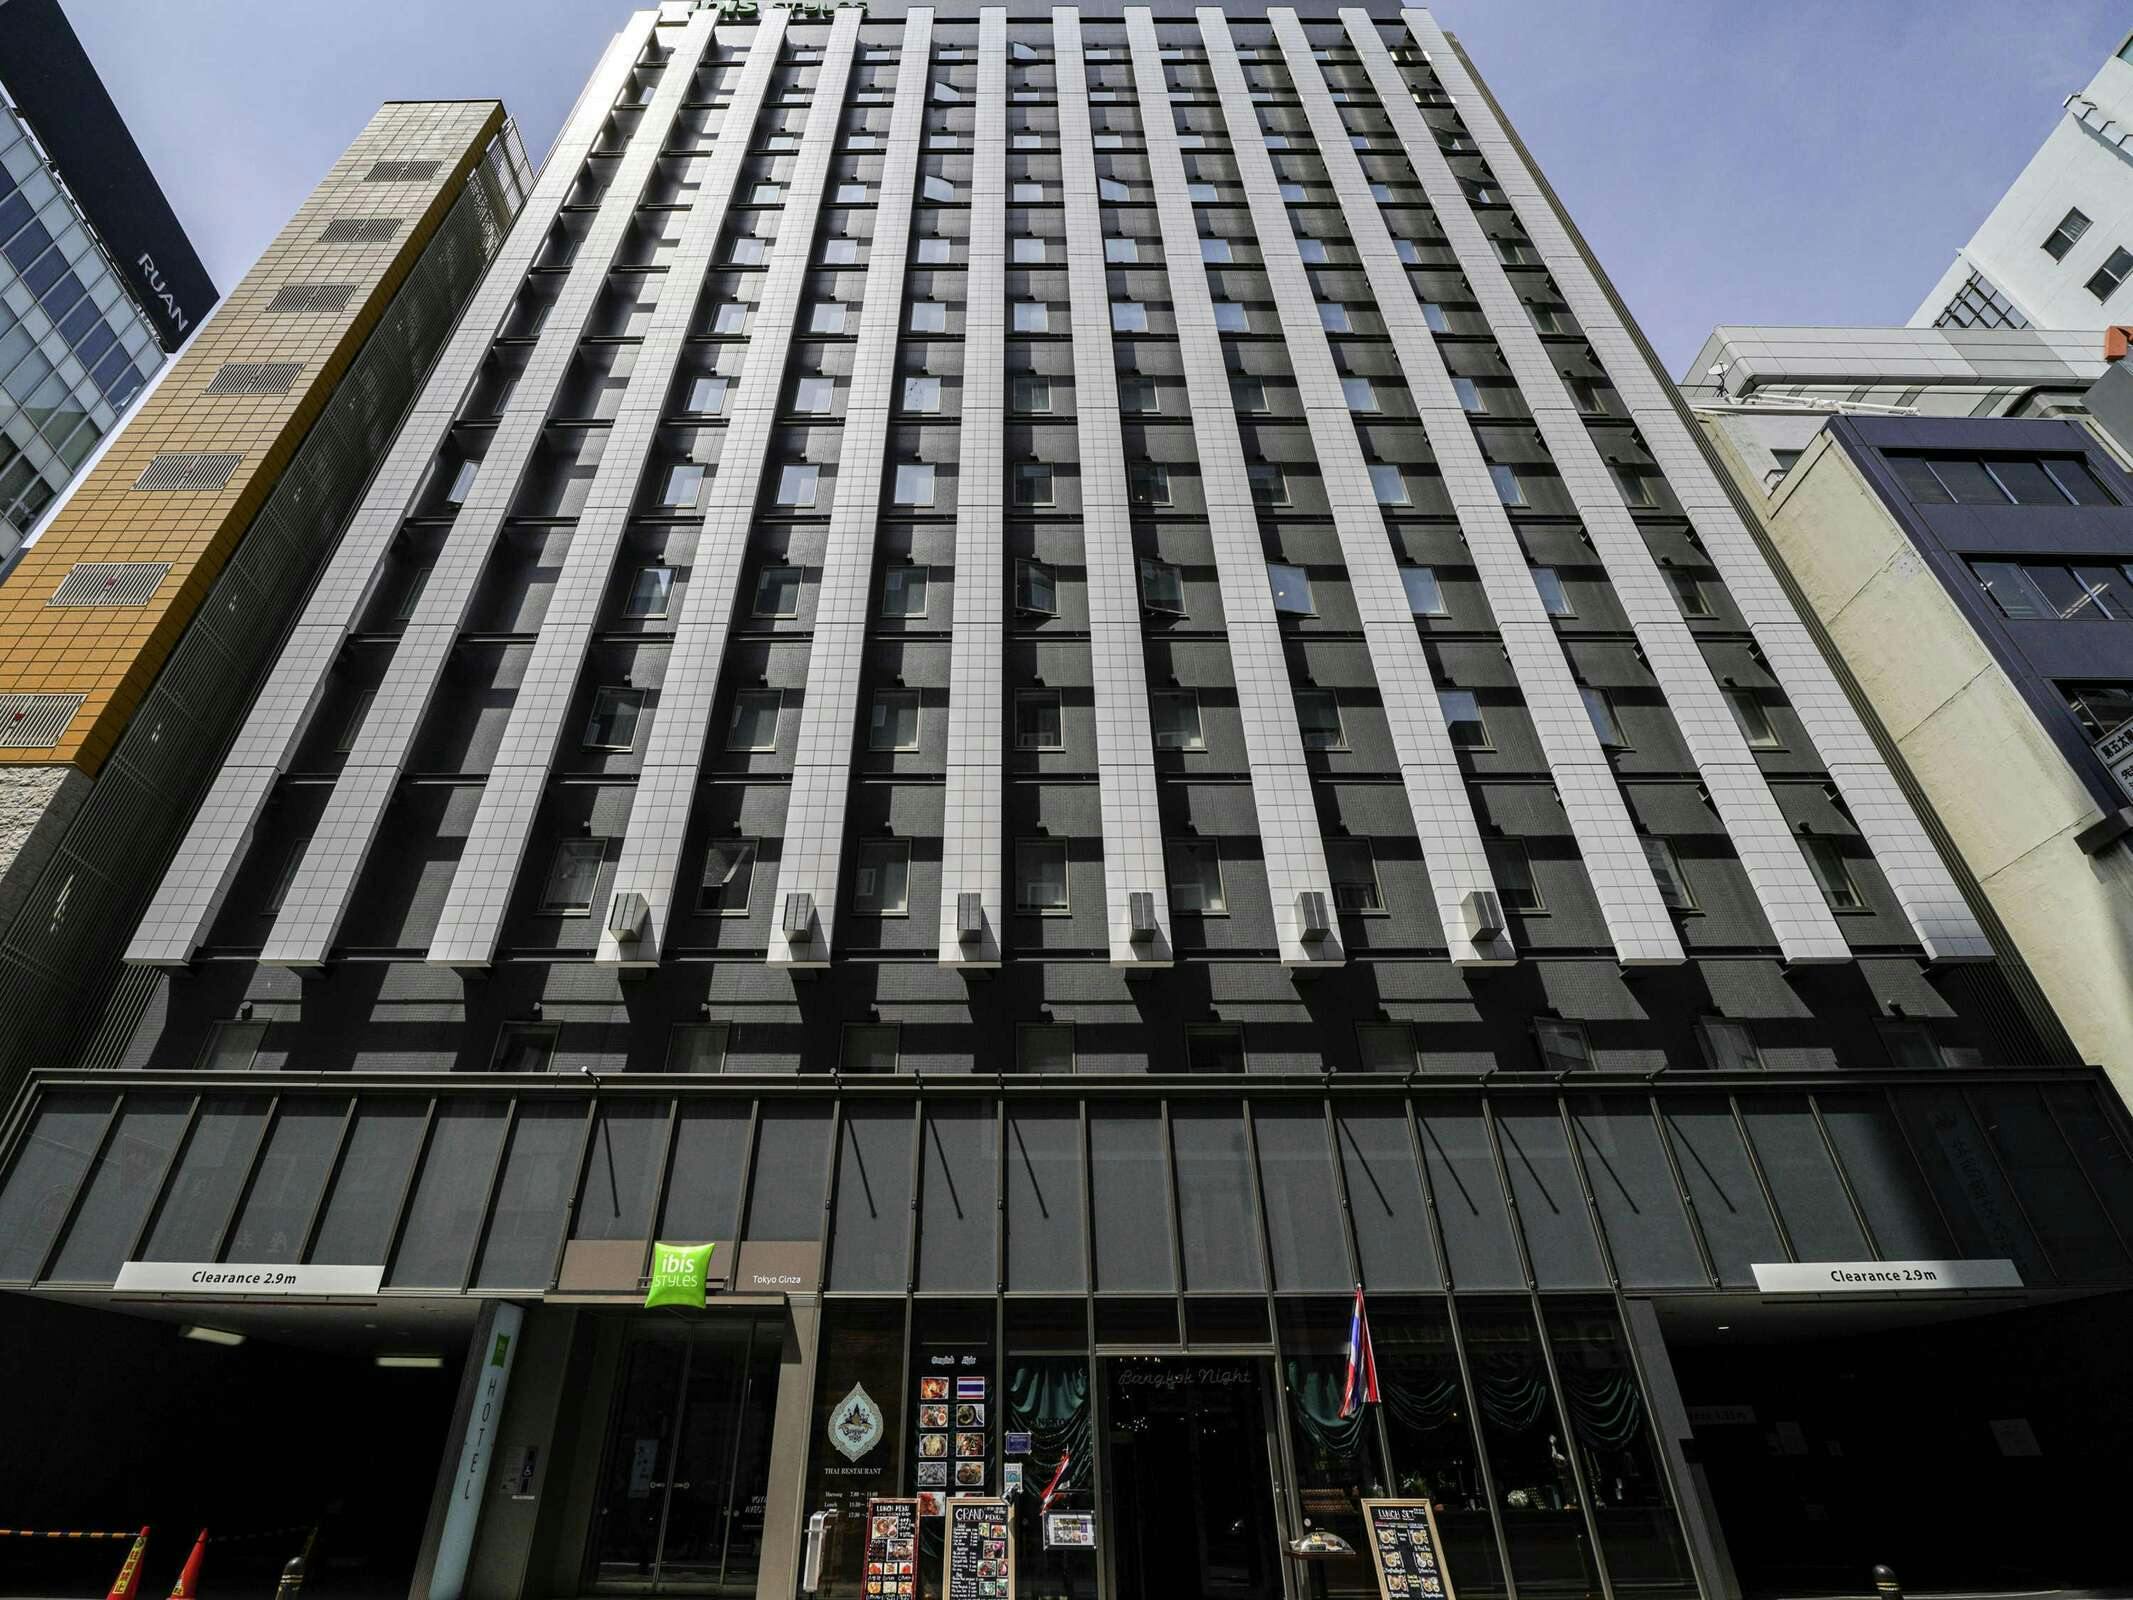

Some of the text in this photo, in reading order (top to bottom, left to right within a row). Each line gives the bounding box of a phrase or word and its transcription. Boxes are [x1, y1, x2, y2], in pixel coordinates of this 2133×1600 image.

[137, 253, 189, 332] RUAN
[661, 1253, 696, 1273] ibis
[191, 1271, 260, 1284] Clearance
[752, 1275, 801, 1285] Tokyo Ginza
[1830, 1269, 1901, 1282] Clearance
[463, 1376, 497, 1500] HOTEL
[824, 1467, 882, 1475] THAI RESTAURANT
[955, 1507, 985, 1521] GRAND
